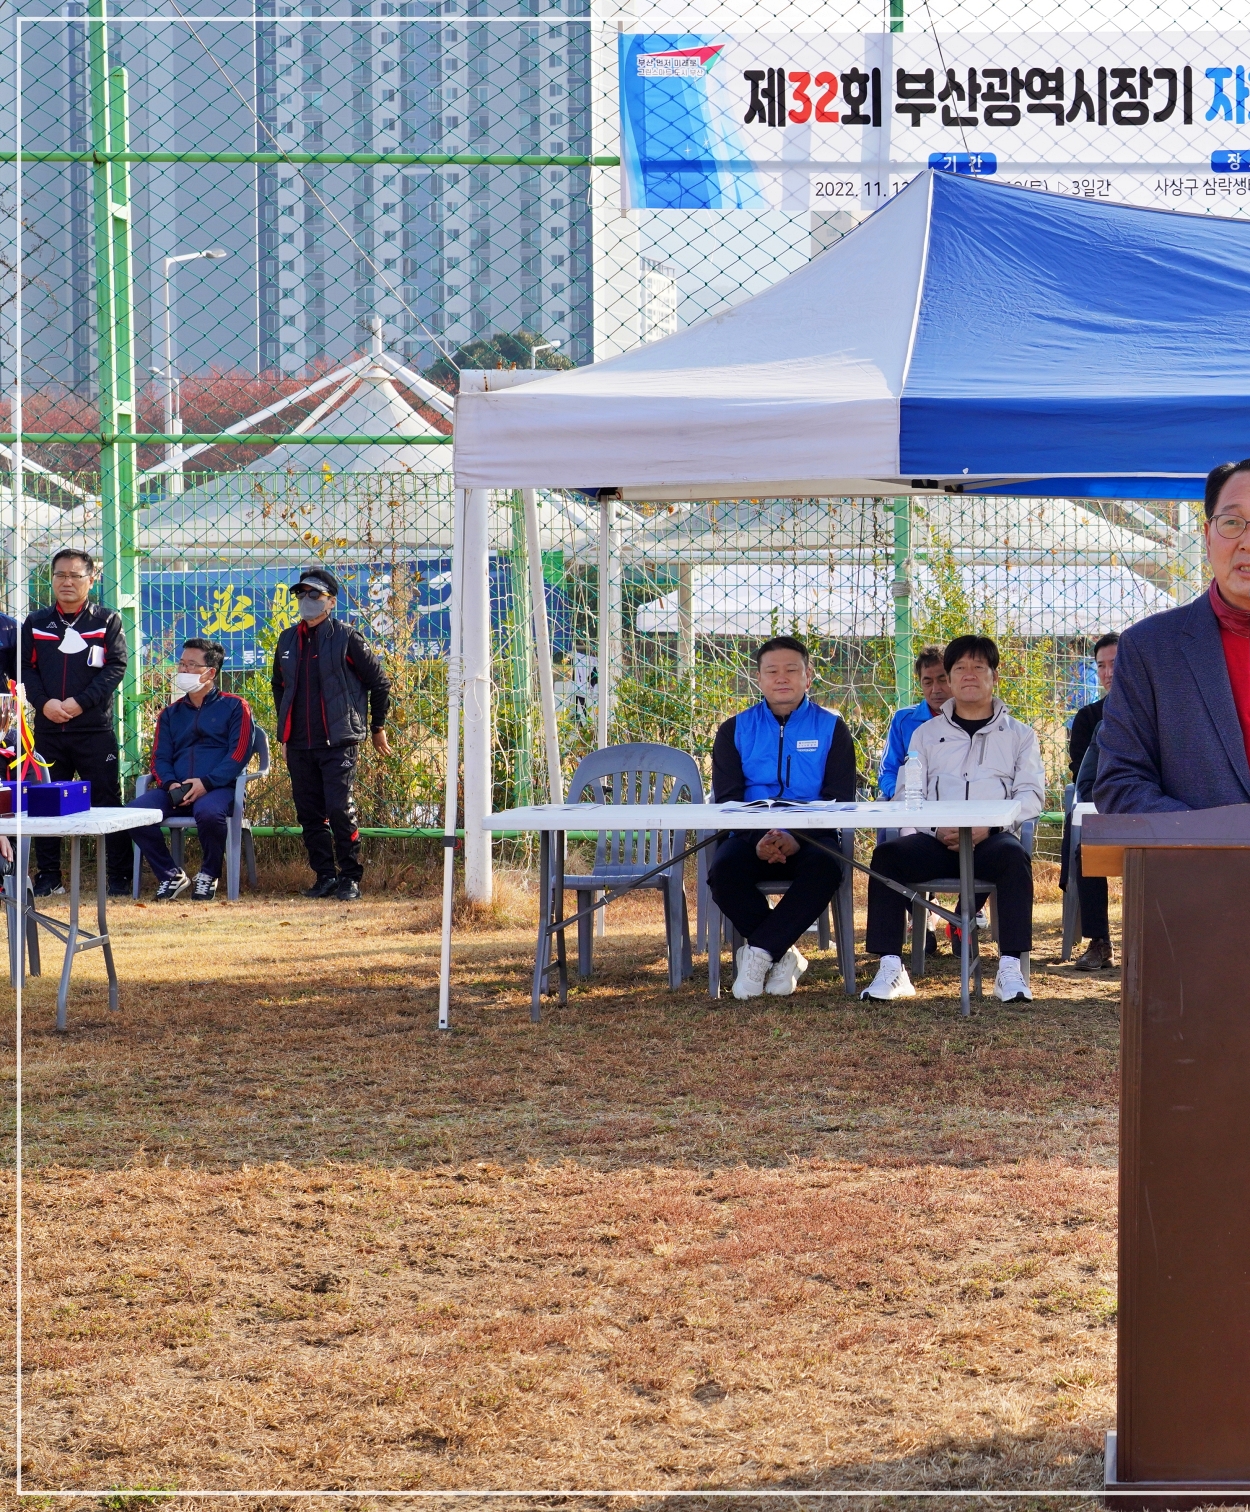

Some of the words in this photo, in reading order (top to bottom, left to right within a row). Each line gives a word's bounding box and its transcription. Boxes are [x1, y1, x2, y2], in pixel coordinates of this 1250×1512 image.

[743, 66, 882, 127] 제32회
[895, 65, 1193, 128] 부산광역시장기
[815, 181, 858, 198] 2022.
[864, 181, 887, 198] 11.
[1154, 177, 1199, 197] 사상구
